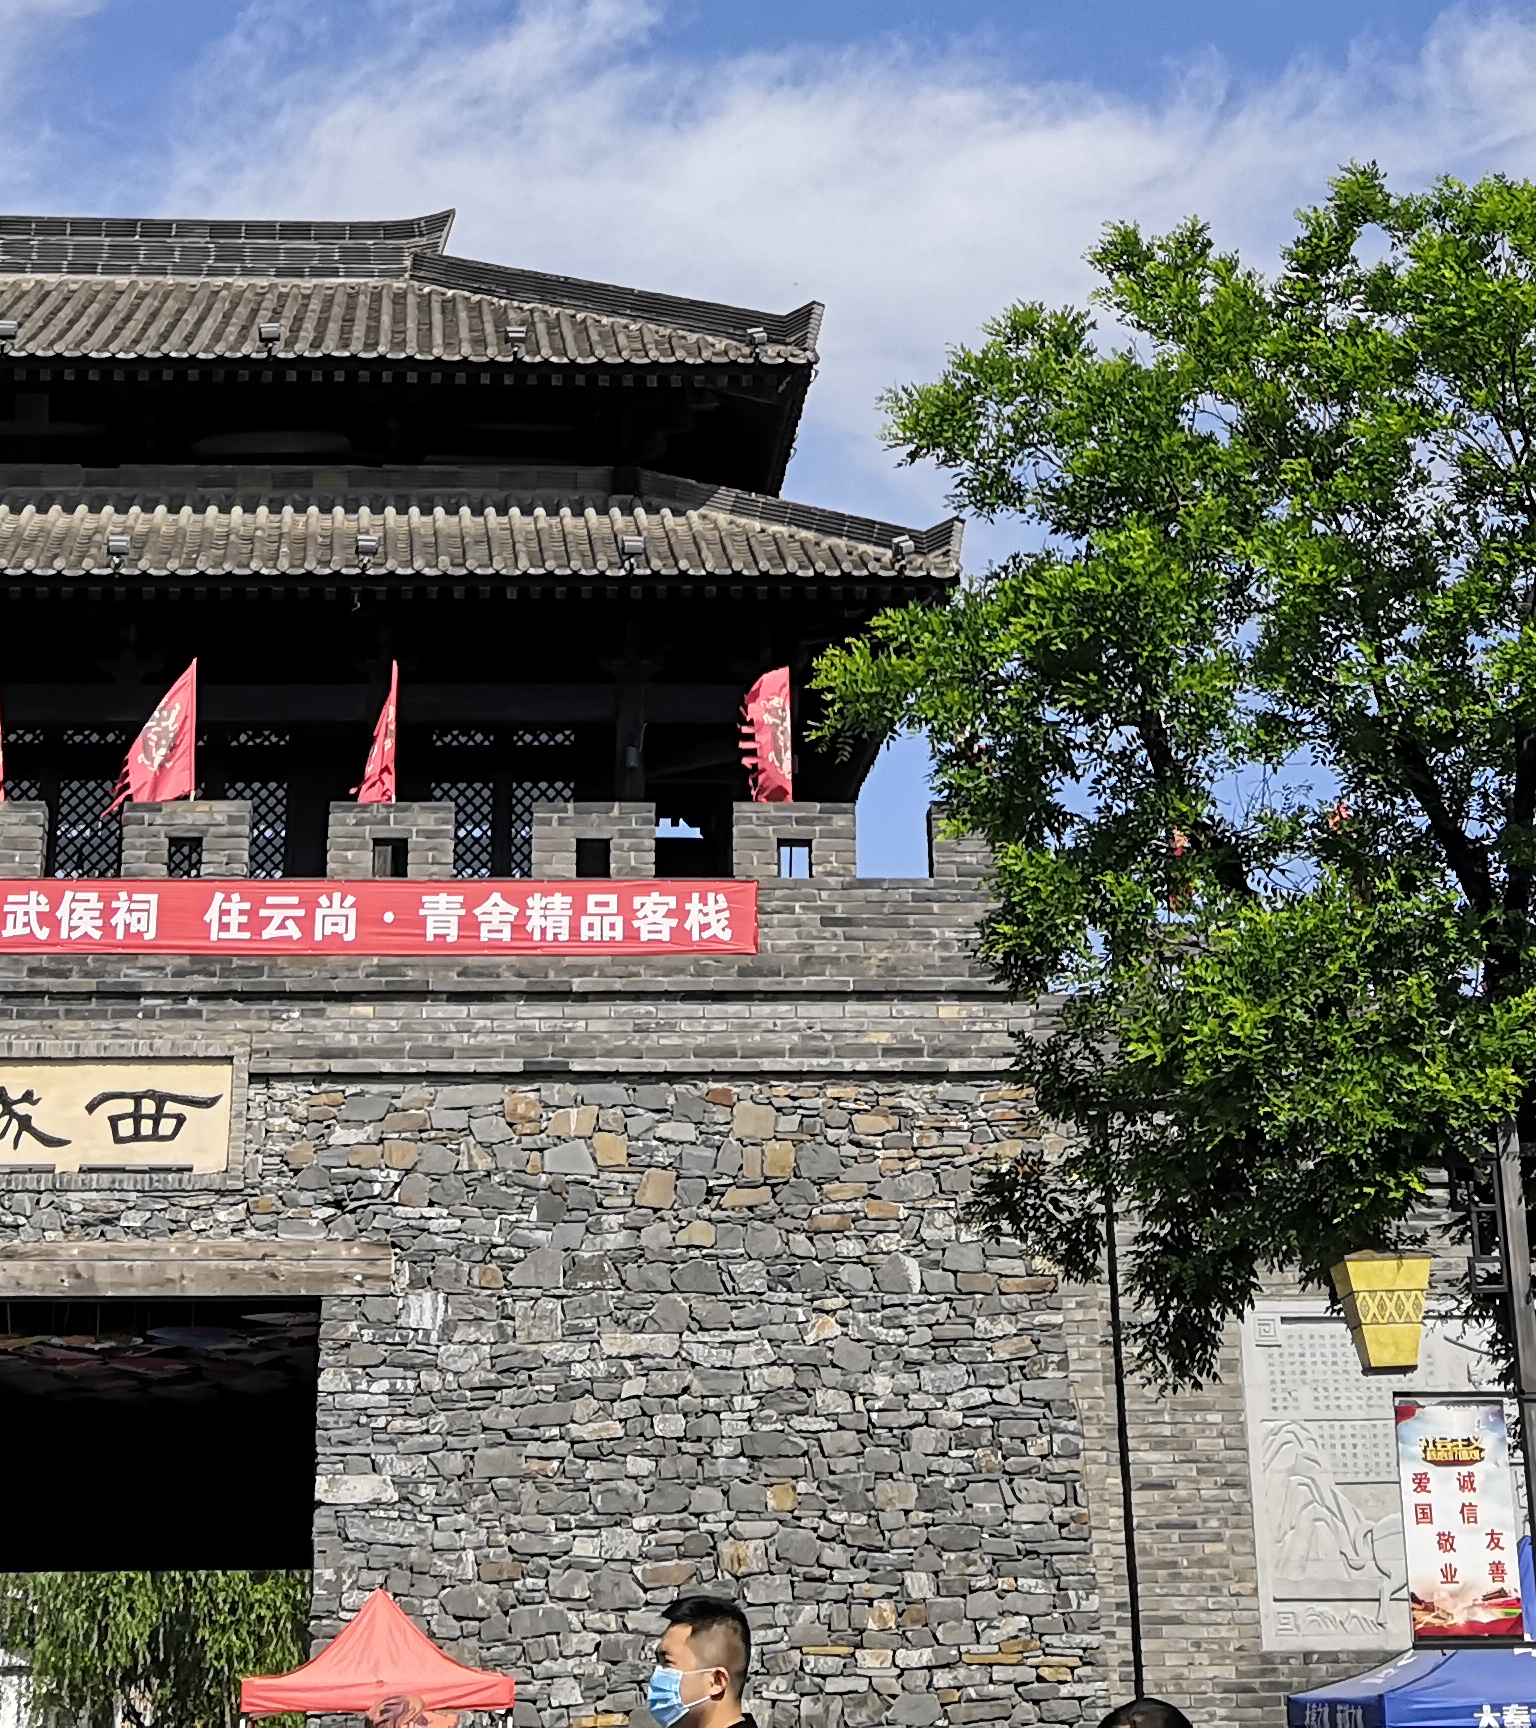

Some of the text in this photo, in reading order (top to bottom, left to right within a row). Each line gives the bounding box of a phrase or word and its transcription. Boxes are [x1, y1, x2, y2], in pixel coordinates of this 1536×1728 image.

[203, 890, 734, 943] 住云尚·青舍精品客栈
[1412, 1472, 1433, 1525] 爱国
[1456, 1471, 1479, 1524] 诚信
[1436, 1531, 1459, 1584] 敬业
[1485, 1529, 1507, 1583] 友善
